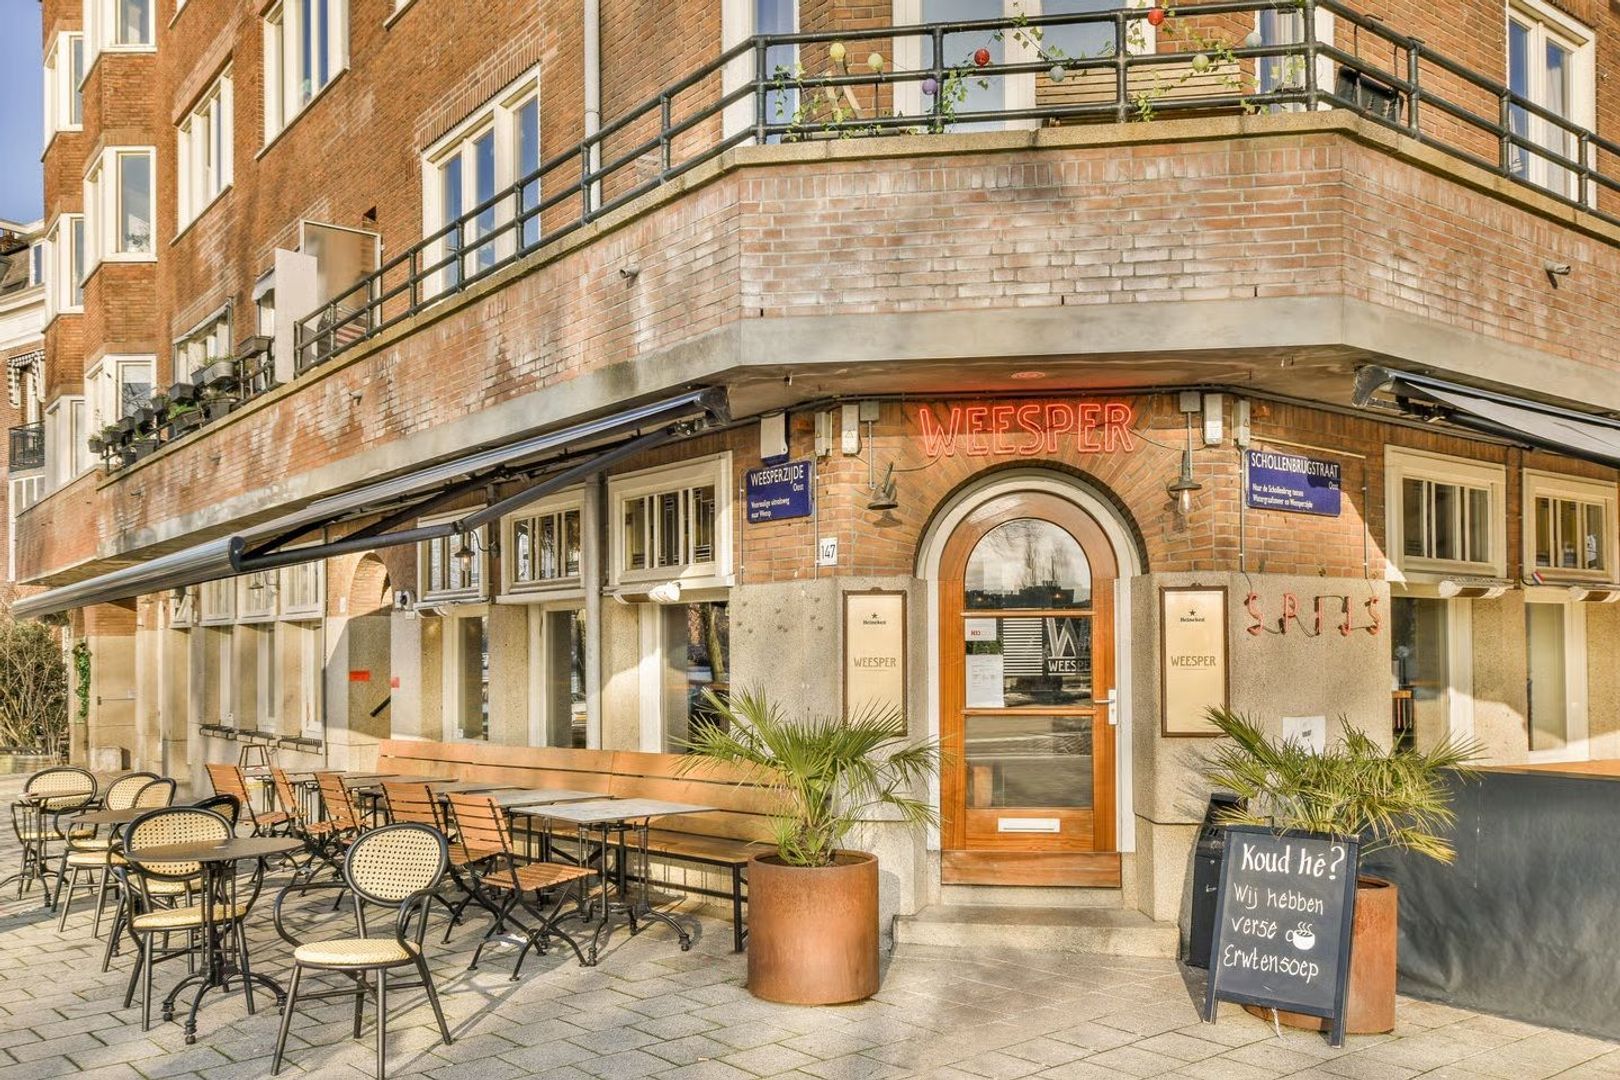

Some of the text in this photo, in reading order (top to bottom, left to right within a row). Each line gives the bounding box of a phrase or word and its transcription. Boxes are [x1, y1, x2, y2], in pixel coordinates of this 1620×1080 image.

[919, 403, 1134, 457] WEESPER
[750, 464, 804, 487] WEESPERZIJDE
[1251, 452, 1338, 478] SCHOLLENBRUGSTRAAT
[822, 544, 836, 560] 147
[853, 656, 897, 668] WEESPER
[1170, 655, 1217, 667] WEESPER
[1241, 843, 1291, 875] Koud
[1233, 882, 1324, 916] Wij hebben
[1231, 916, 1278, 940] verse
[1223, 943, 1319, 984] Erwtensoep
